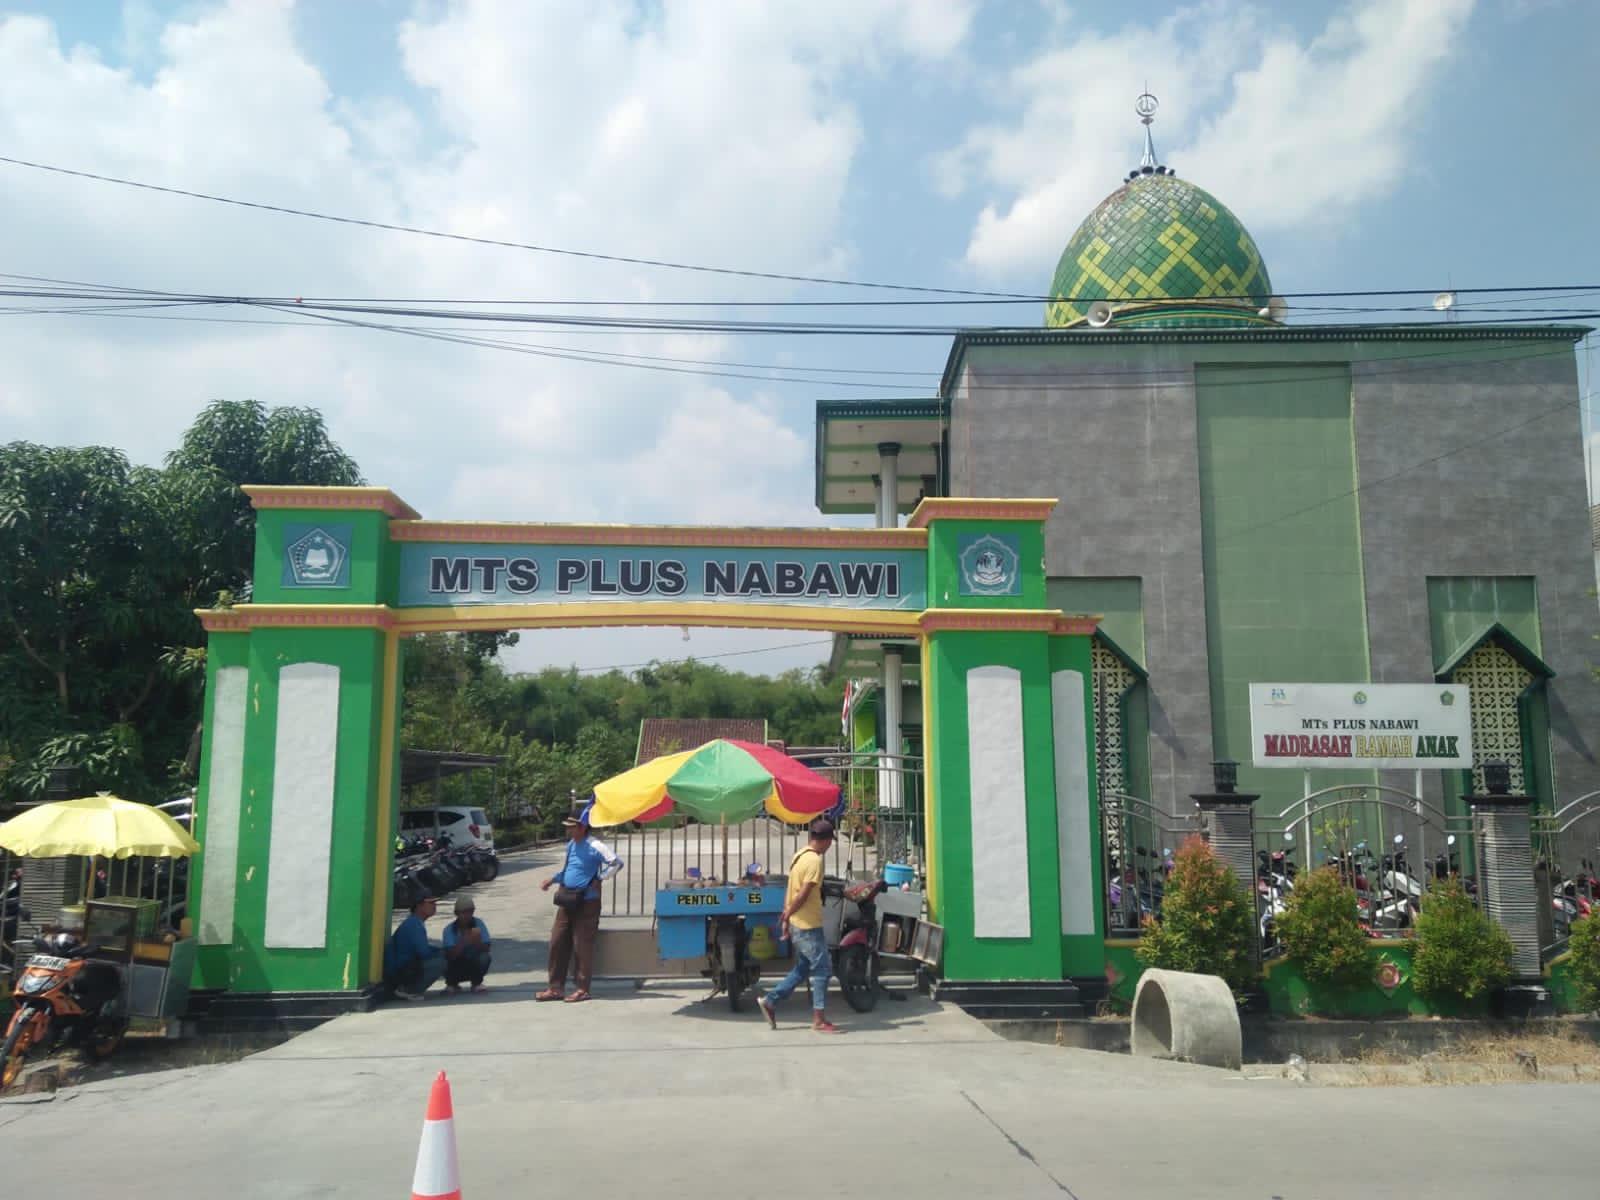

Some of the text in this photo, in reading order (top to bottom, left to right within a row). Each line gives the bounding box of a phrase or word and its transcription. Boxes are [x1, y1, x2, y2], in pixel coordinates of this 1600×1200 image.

[429, 556, 900, 598] MTS PLUS NABAWI
[1301, 719, 1419, 730] MTs PLUS NABAWI
[1264, 734, 1460, 758] MADRASAH RAMAH ANAK
[677, 893, 720, 905] PENTOL
[748, 892, 762, 904] ES
